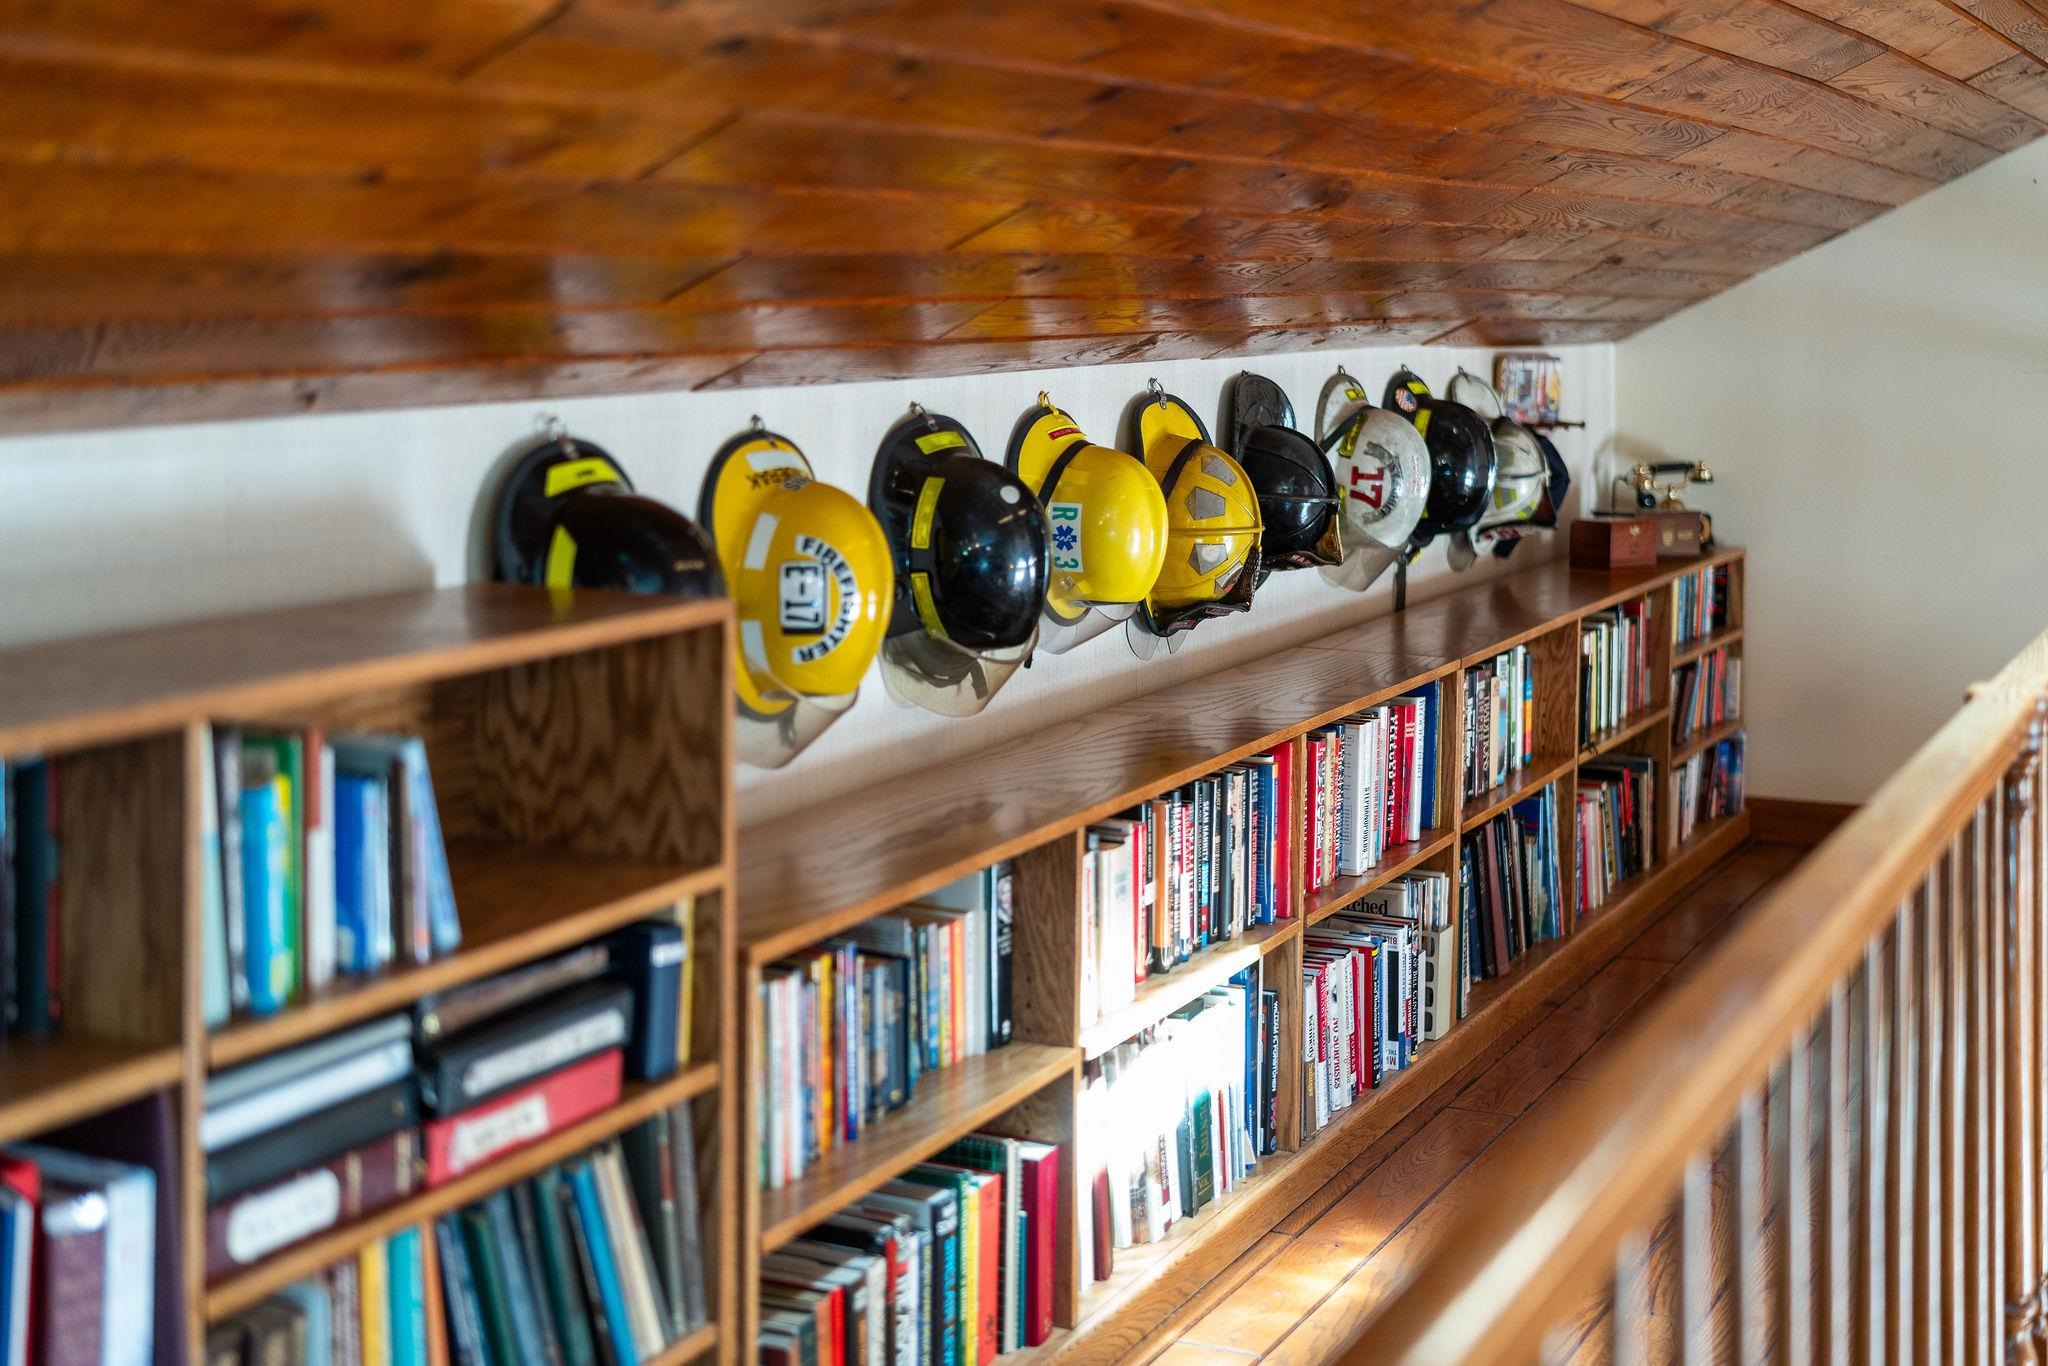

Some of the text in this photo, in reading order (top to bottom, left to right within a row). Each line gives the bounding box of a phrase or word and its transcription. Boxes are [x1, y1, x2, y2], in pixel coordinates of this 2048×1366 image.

[1350, 466, 1384, 510] 17
[1051, 506, 1079, 569] R 3
[785, 566, 819, 623] E-17
[1412, 957, 1417, 969] OF
[1333, 1017, 1341, 1089] NO SURPRISES
